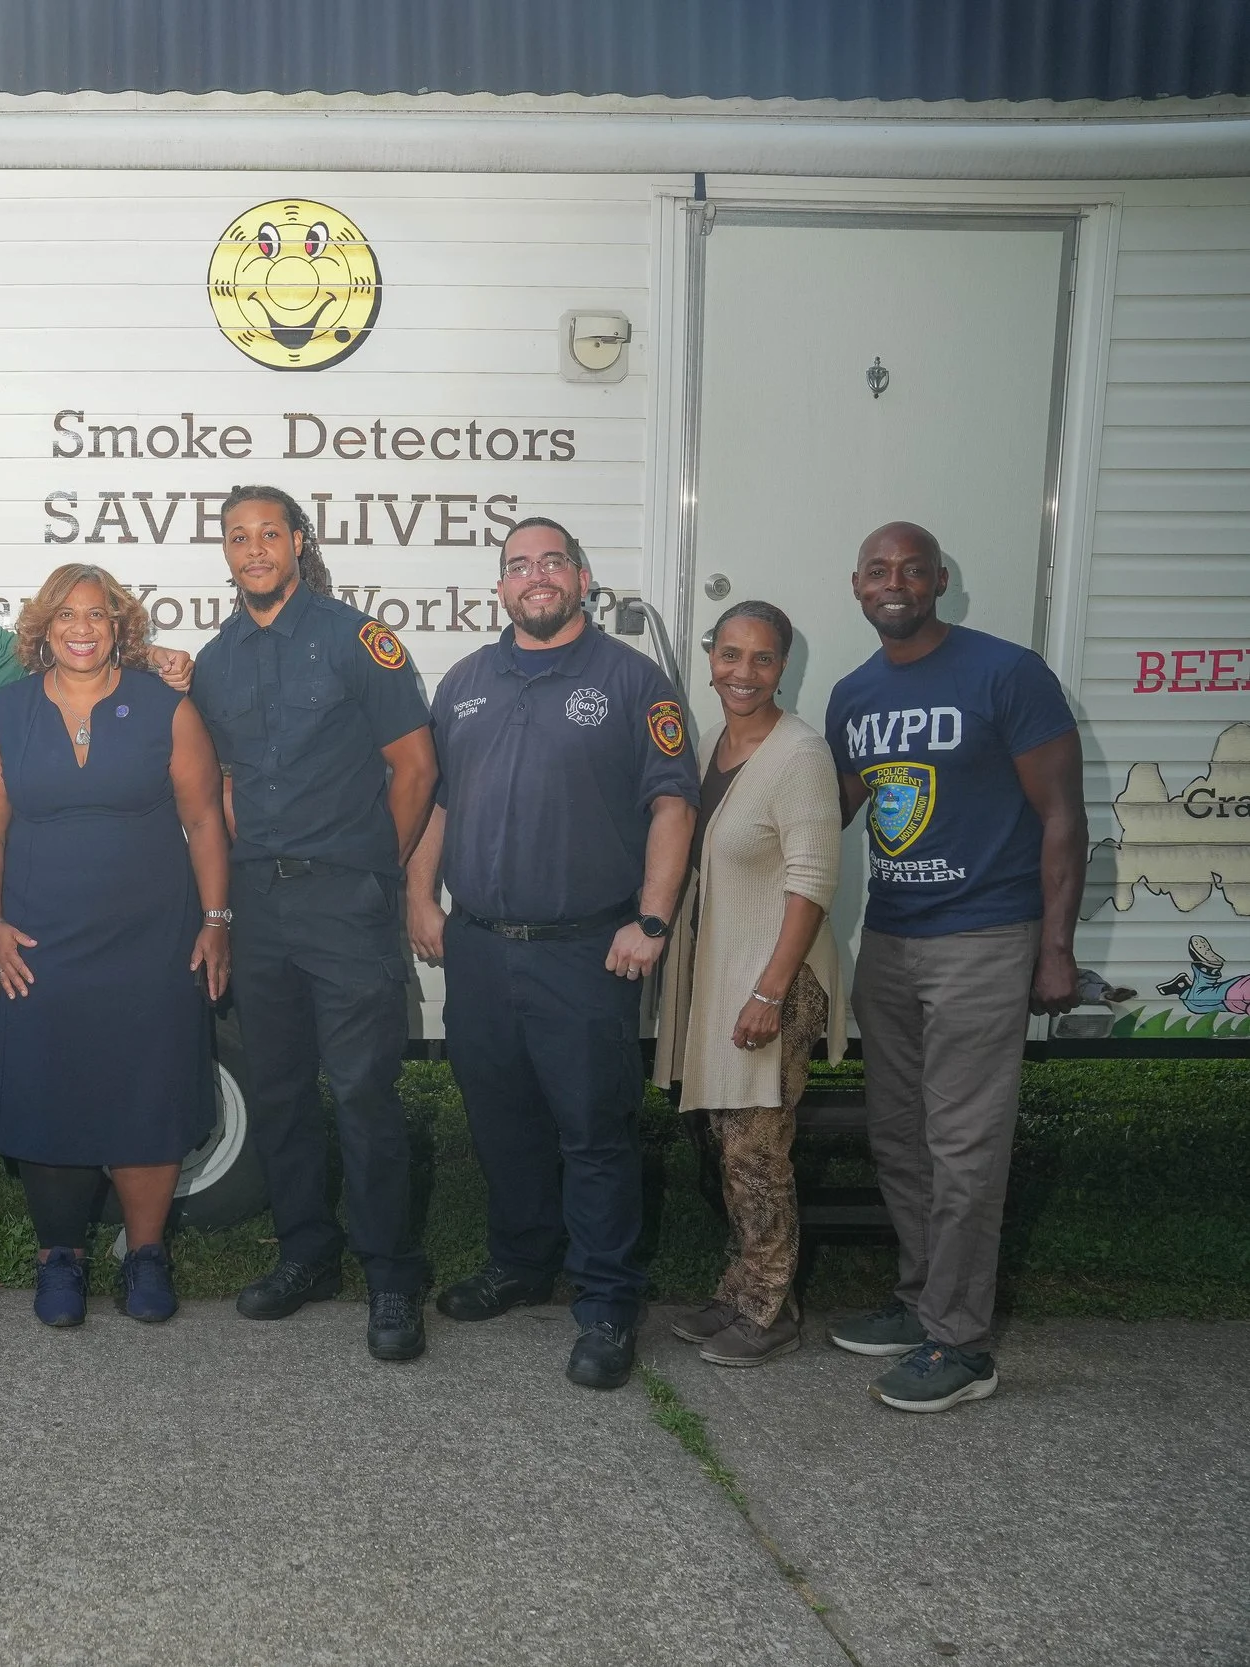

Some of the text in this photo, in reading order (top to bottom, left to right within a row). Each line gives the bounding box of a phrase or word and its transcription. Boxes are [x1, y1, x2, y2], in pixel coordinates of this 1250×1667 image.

[52, 409, 577, 462] Smoke Detectors
[44, 490, 519, 547] SAVE LIVES
[453, 697, 487, 713] INSPECTOR
[578, 701, 596, 712] 603
[846, 706, 962, 759] MVPD
[877, 767, 910, 778] POLICE
[898, 795, 928, 843] MOUNT VERNON
[882, 867, 967, 883] FALLEN
